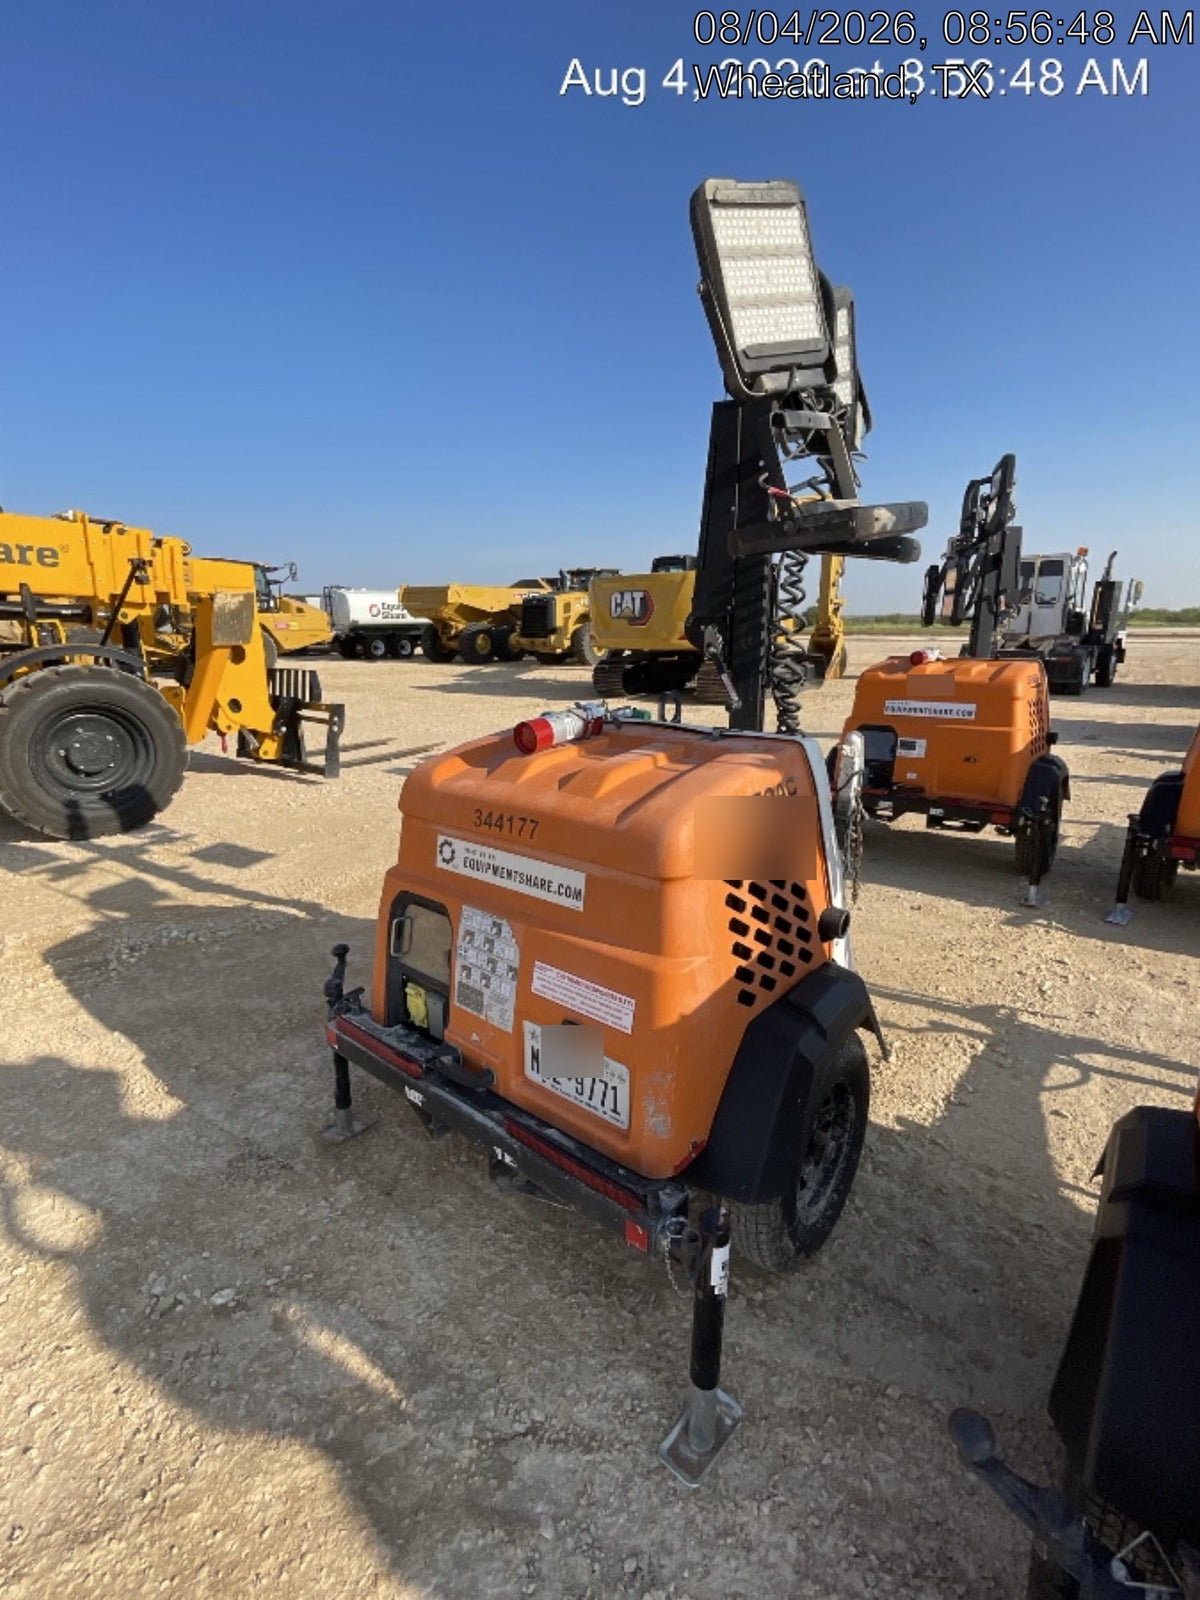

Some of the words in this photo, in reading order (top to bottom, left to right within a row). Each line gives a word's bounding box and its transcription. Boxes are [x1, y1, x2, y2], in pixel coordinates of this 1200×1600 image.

[610, 591, 645, 618] CAT
[473, 808, 540, 840] 344177
[463, 856, 583, 902] EQUIPMENTSHARE.COM
